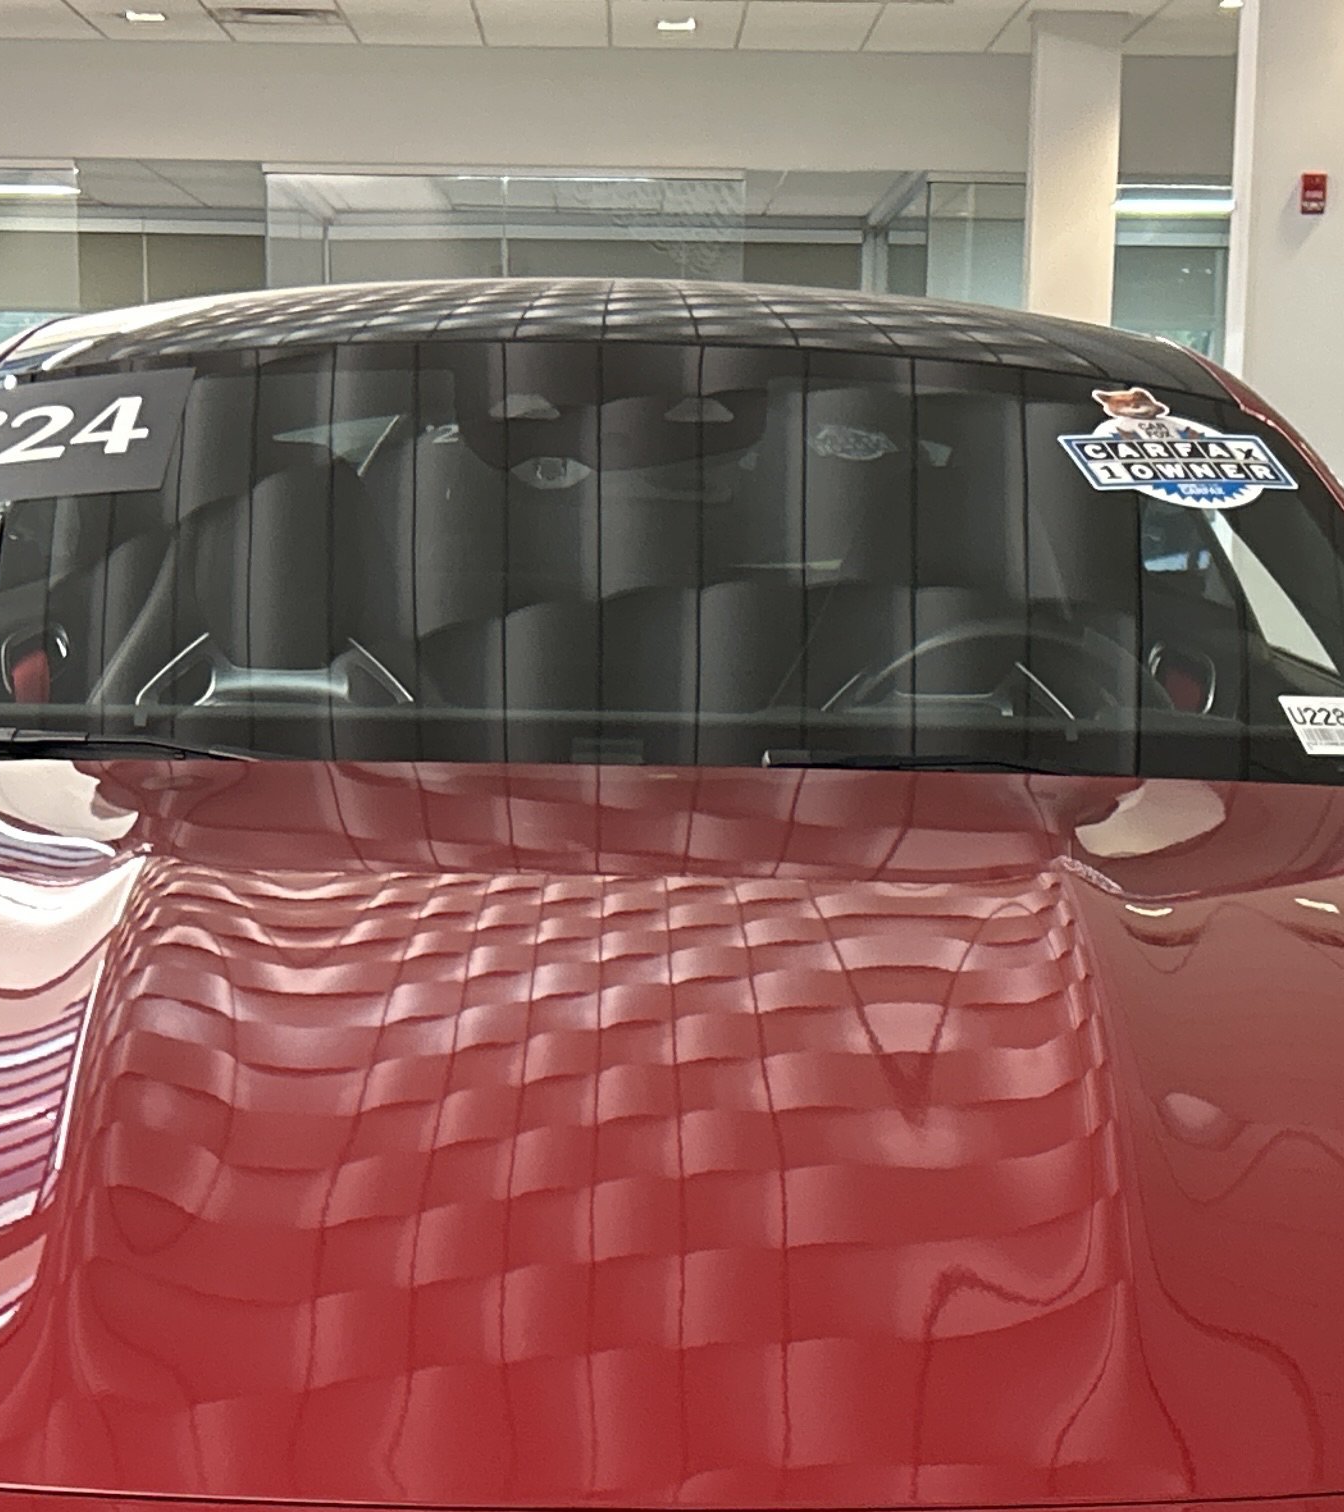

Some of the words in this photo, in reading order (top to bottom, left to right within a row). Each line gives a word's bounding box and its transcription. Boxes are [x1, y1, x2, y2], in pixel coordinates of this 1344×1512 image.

[1083, 441, 1260, 461] CARFAX
[1100, 463, 1123, 480] 1
[1132, 462, 1276, 480] OWNER
